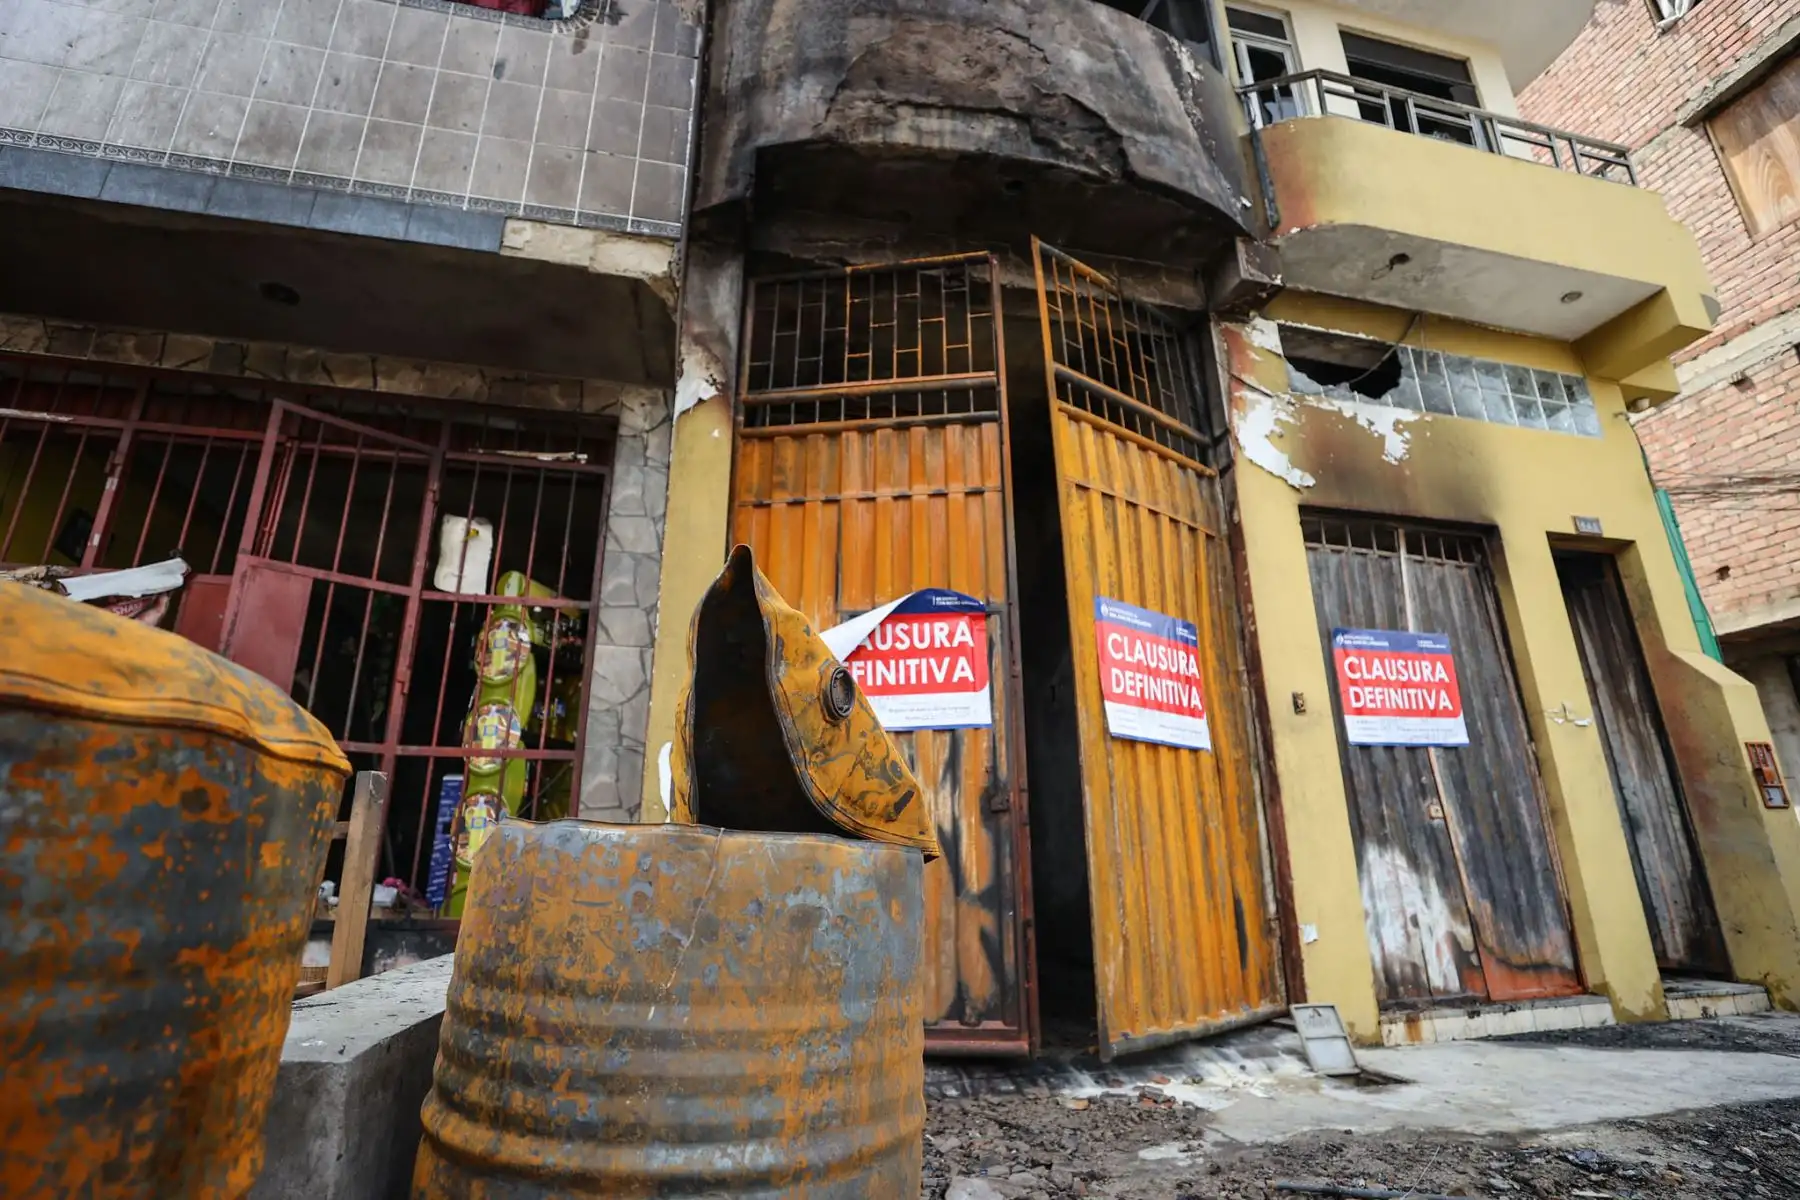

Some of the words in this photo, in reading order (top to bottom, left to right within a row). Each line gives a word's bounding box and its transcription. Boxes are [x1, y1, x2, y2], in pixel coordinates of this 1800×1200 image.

[861, 621, 975, 651] USURA
[1107, 632, 1200, 680] CLAUSURA
[1343, 656, 1450, 683] CLAUSURA
[842, 656, 975, 687] FINITIVA
[1111, 667, 1203, 711] DEFINITIVA
[1349, 686, 1453, 711] DEFINITIVA
